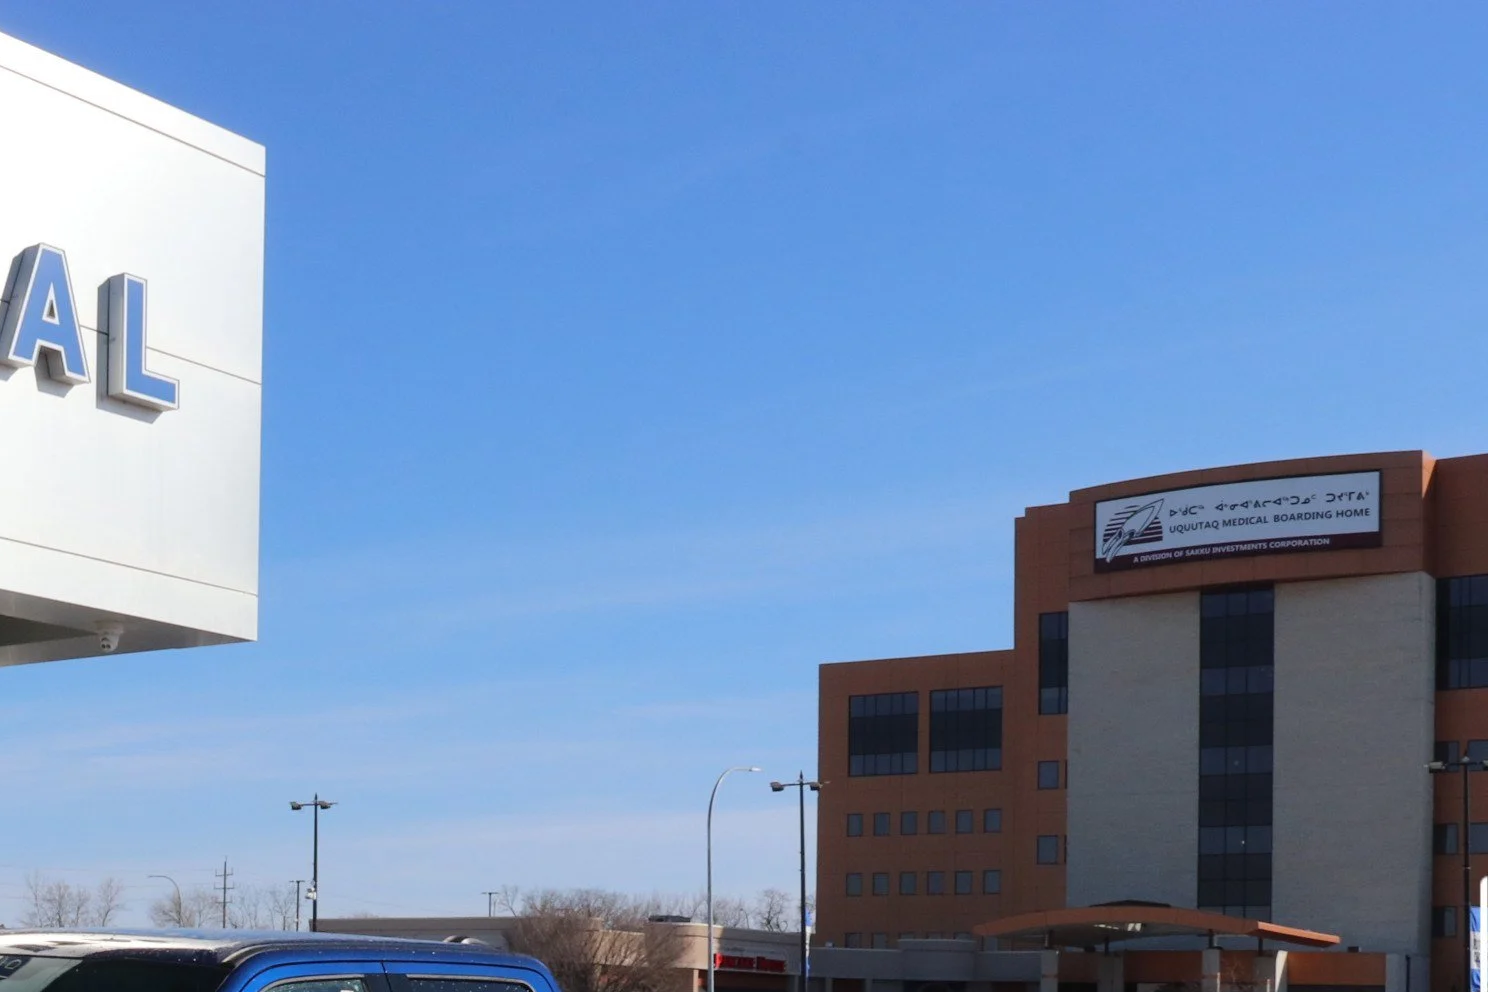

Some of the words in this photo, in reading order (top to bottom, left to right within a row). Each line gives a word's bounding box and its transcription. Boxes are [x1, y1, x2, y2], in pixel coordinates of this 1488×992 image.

[1169, 520, 1220, 534] UQUUTAQ
[1222, 515, 1269, 528] MEDICAL
[1273, 510, 1333, 523] BOARDING
[1335, 507, 1371, 518] HOME
[1132, 554, 1140, 564] A
[1140, 550, 1173, 563] DIVISION
[1173, 548, 1185, 558] OF
[1212, 540, 1268, 554] INVESTMENTS
[1269, 536, 1331, 549] CORPORATION
